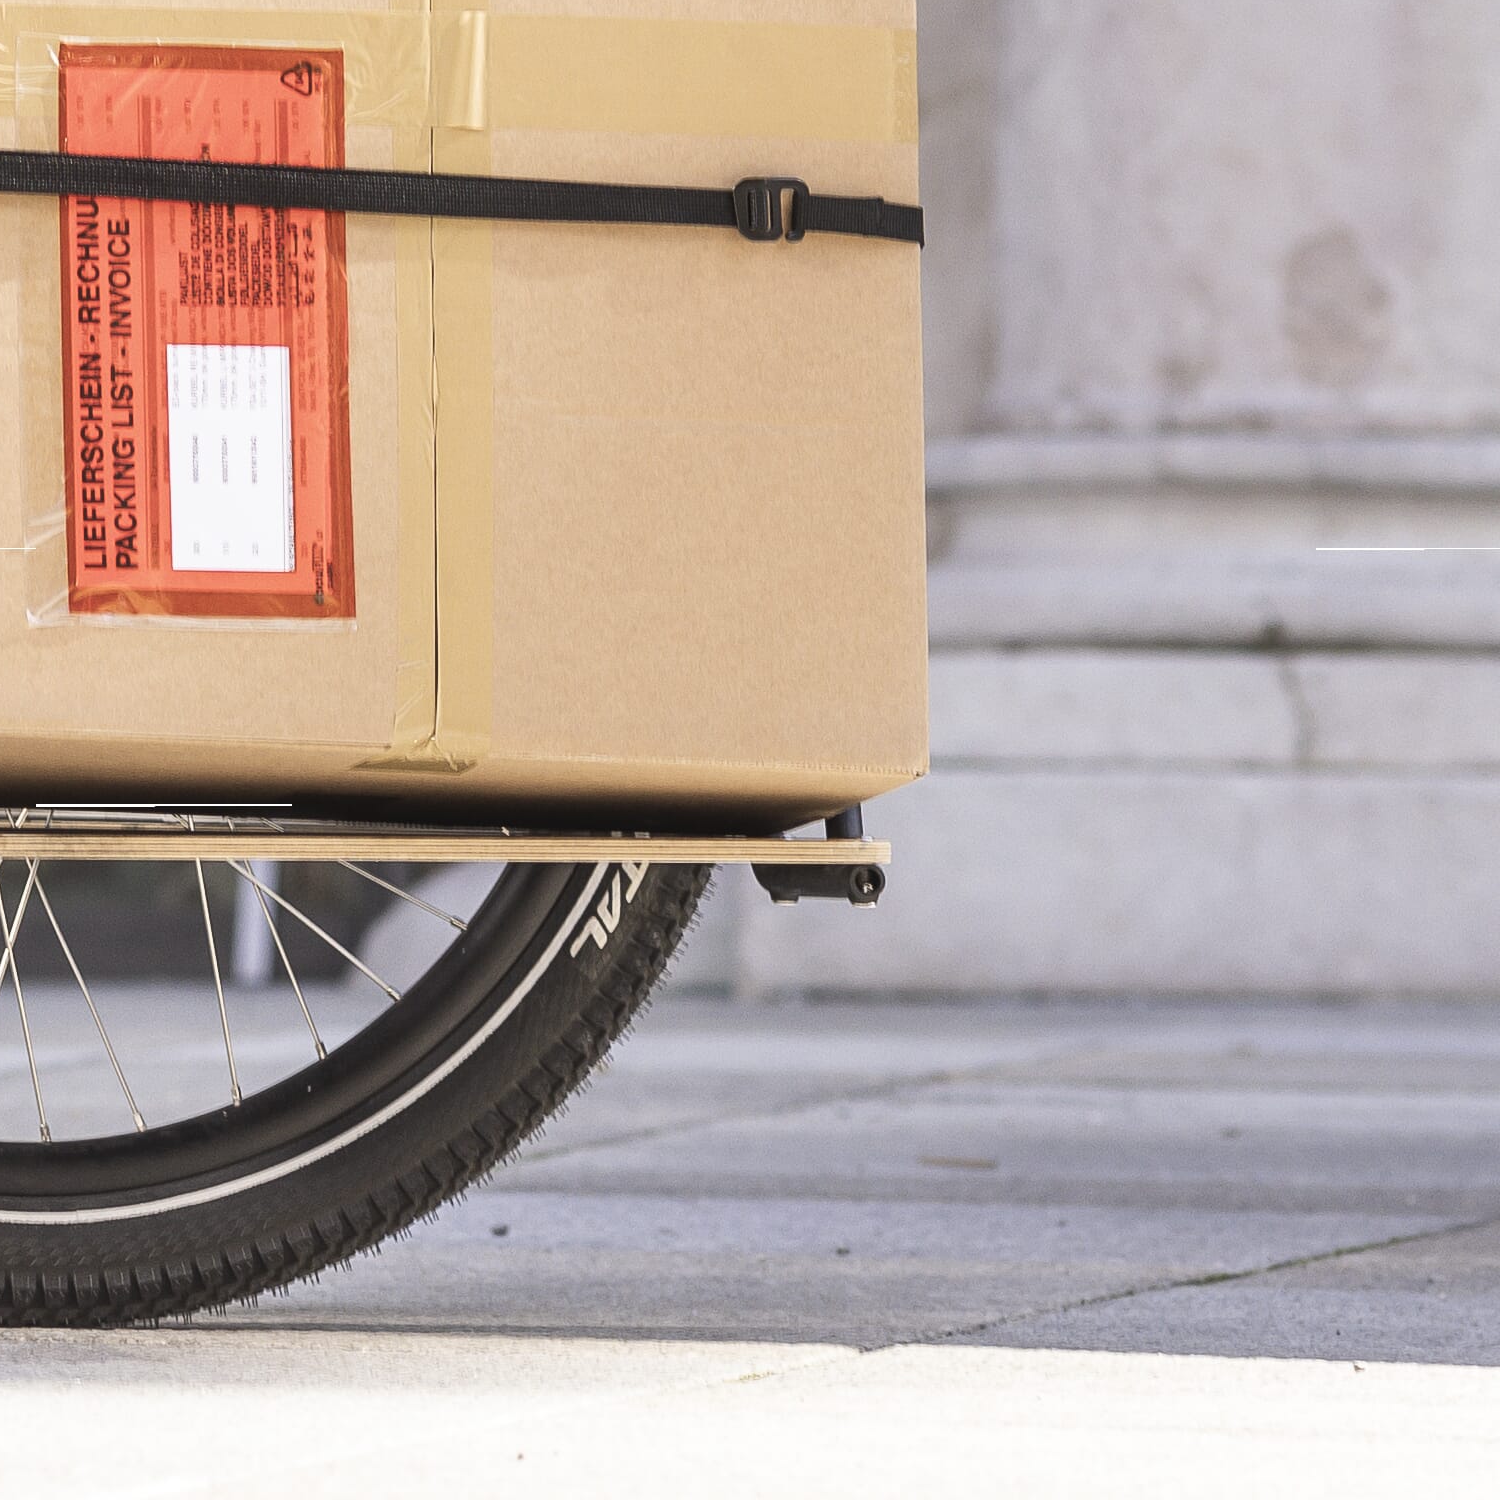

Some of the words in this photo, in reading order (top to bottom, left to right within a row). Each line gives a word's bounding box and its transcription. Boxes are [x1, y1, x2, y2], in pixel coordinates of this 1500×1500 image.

[76, 196, 101, 325] RECHNU
[108, 218, 132, 339] INVOICE
[110, 364, 135, 429] LIST
[79, 353, 108, 570] LIEFERSCHEIN
[113, 436, 139, 570] PACKING
